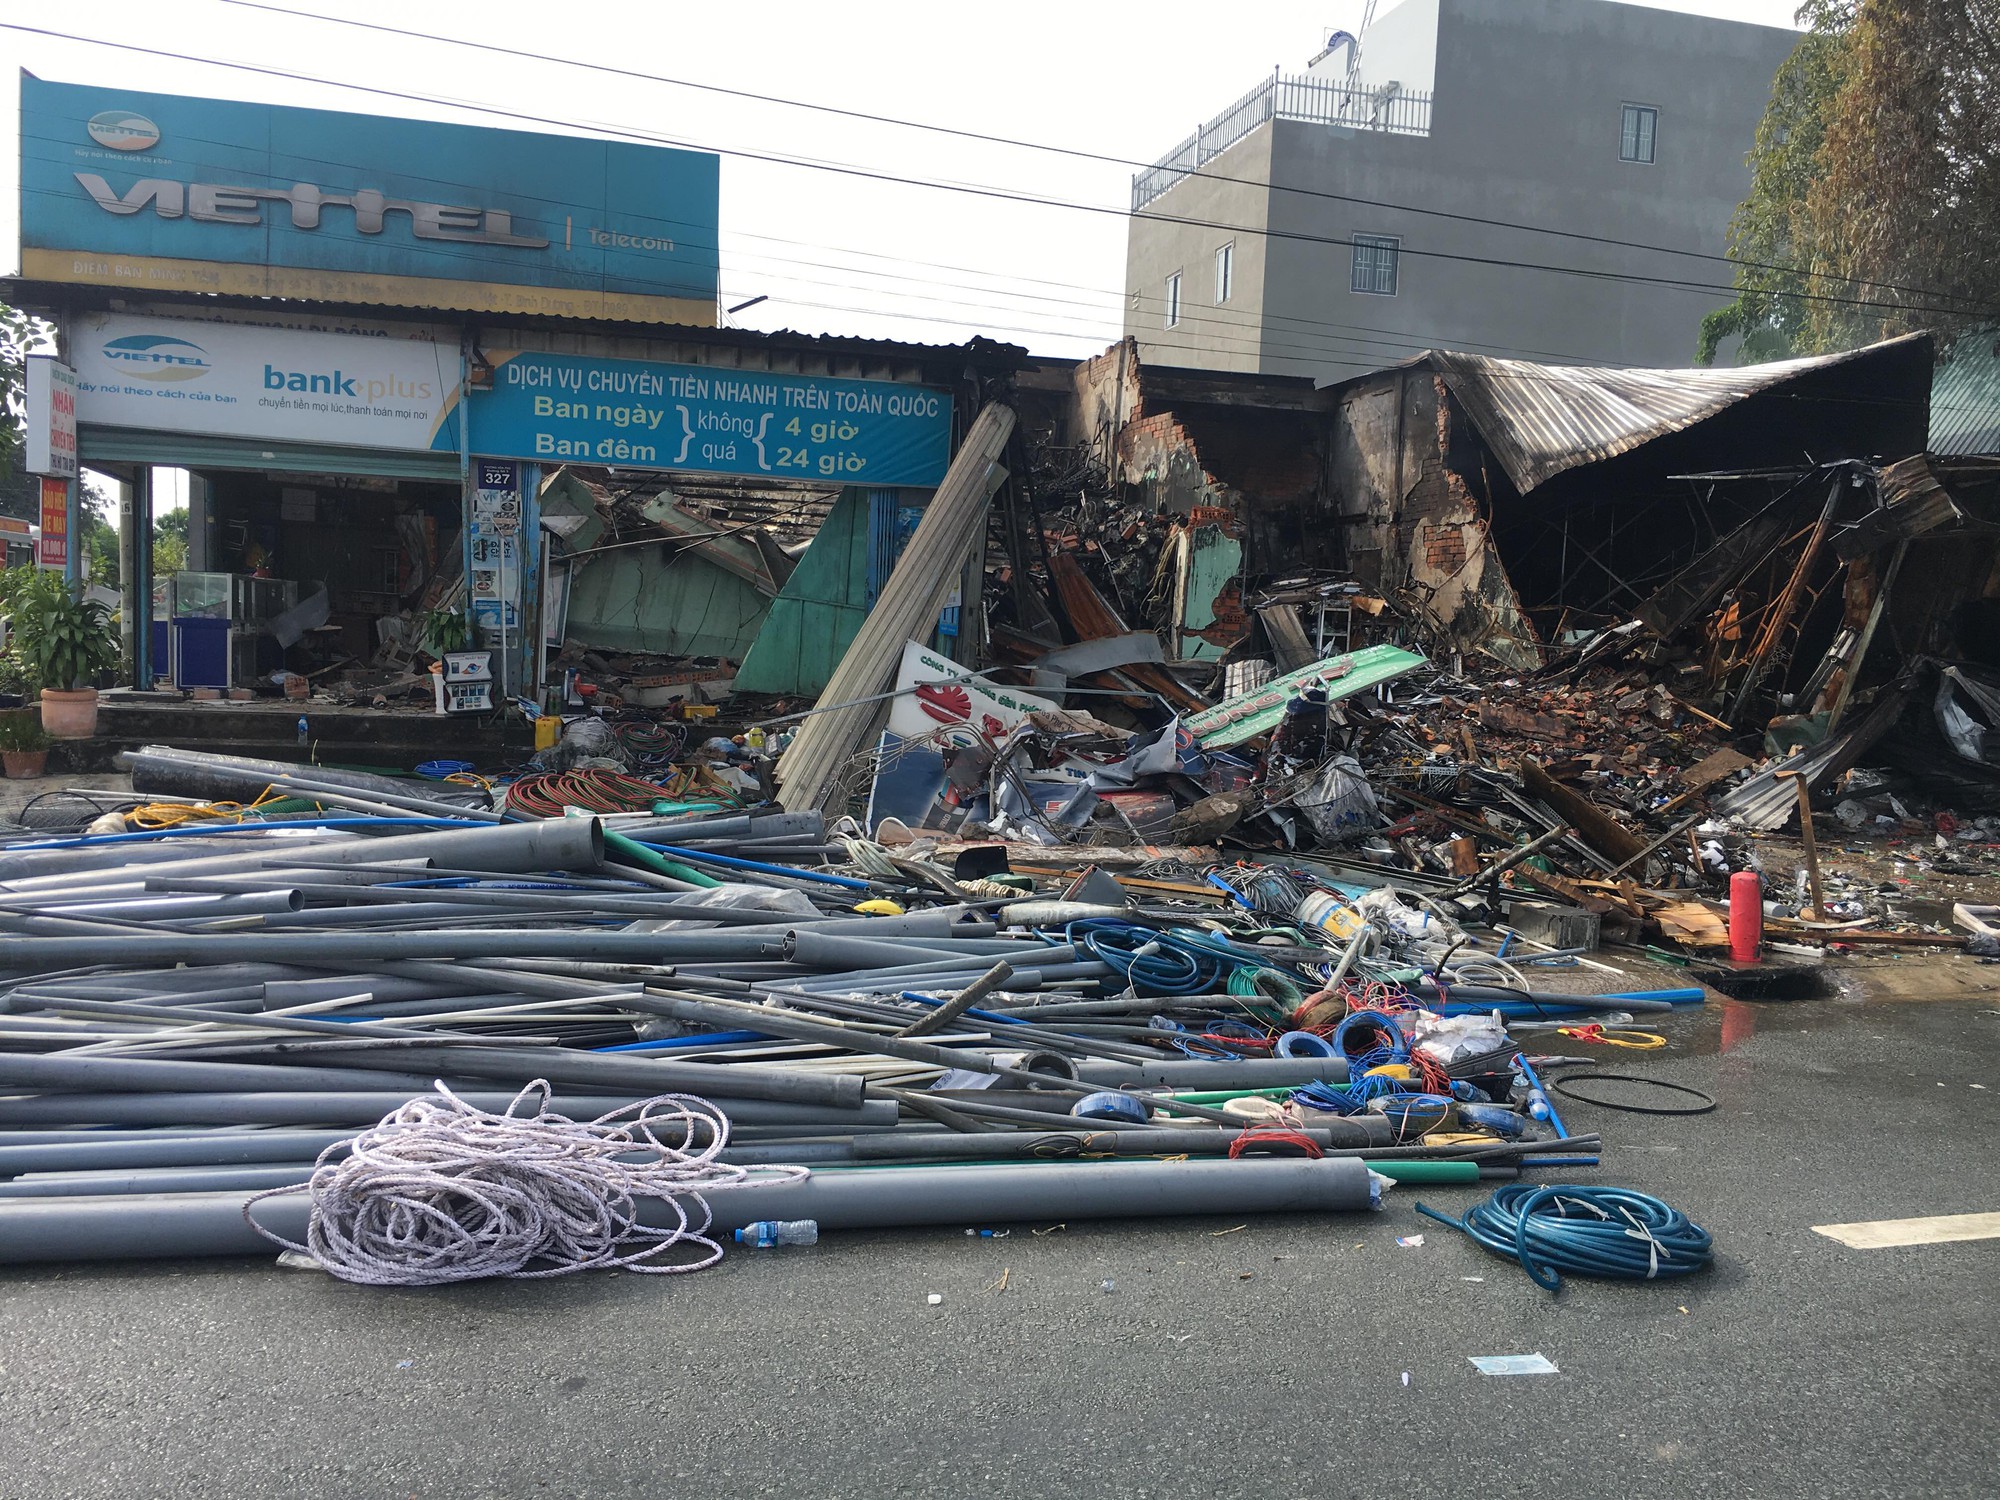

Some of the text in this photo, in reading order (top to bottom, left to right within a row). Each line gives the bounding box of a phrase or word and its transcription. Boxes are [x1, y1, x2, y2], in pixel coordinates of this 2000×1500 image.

[73, 172, 549, 249] VIETTEL
[589, 229, 674, 252] Telecom
[102, 350, 212, 367] VIETTEL
[100, 384, 120, 394] nói
[124, 386, 153, 396] theo
[157, 388, 185, 400] cách
[189, 391, 211, 402] của
[215, 393, 238, 404] bạn
[264, 364, 431, 403] bank plus
[508, 364, 939, 418] DỊCH VỤ CHUYỂN TIỀN NHANH TRÊN TOÀN QUỐC
[258, 395, 291, 410] chuyển
[294, 396, 310, 410] tiền
[312, 400, 328, 413] mọi
[373, 405, 393, 417] toán
[395, 408, 411, 420] mọi
[413, 409, 428, 420] nơi
[534, 396, 664, 430] Ban ngày
[698, 410, 754, 439] không
[785, 417, 860, 444] 4 giờ
[535, 433, 656, 461] Ban đêm
[702, 441, 737, 463] quá
[776, 447, 867, 475] 24 giờ
[485, 473, 510, 484] 327
[920, 655, 944, 673] CÔNG
[947, 668, 959, 679] TY
